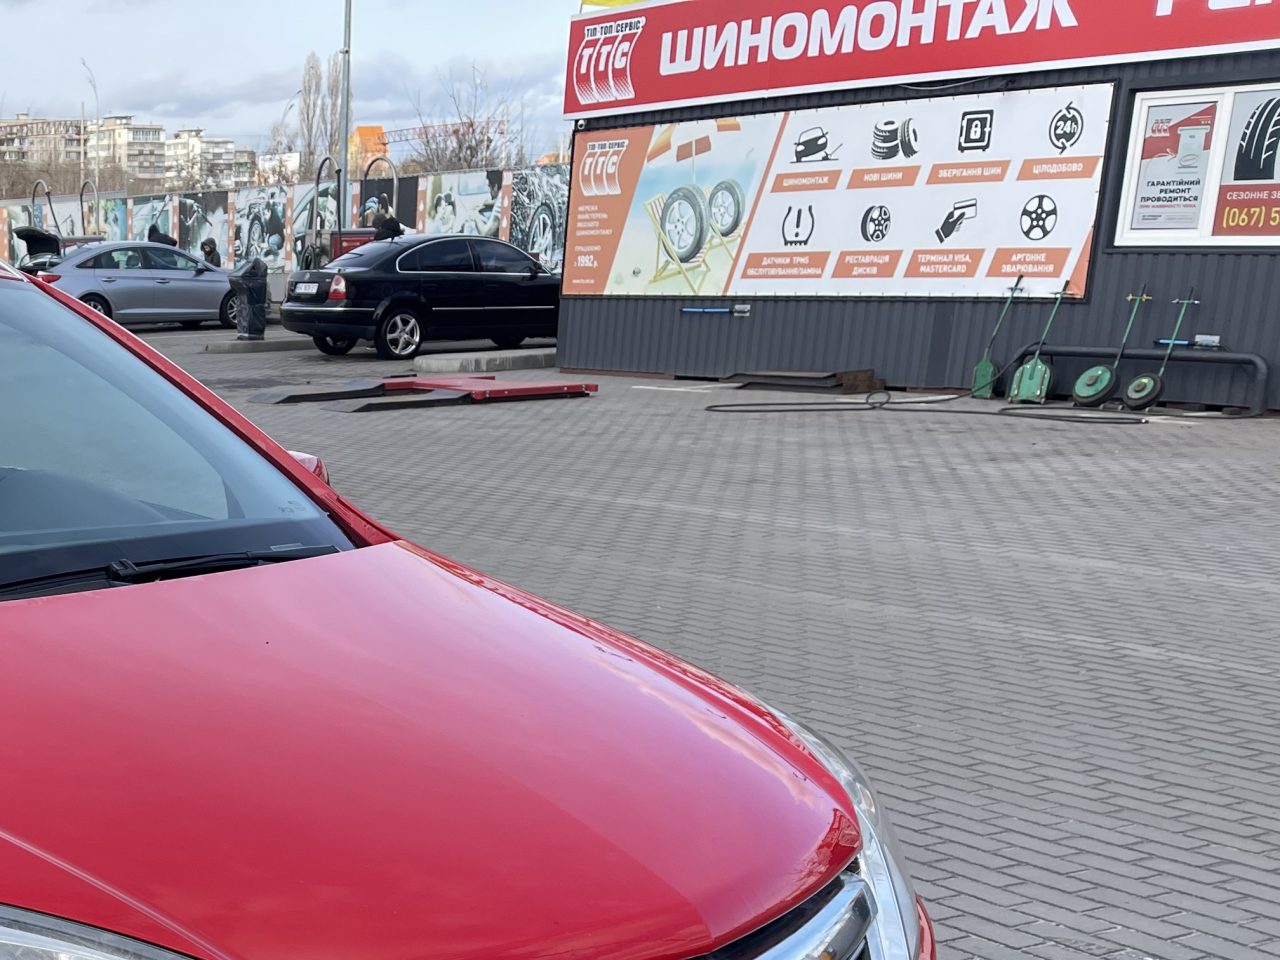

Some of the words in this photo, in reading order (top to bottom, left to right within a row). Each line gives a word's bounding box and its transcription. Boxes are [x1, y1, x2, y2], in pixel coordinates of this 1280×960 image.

[615, 20, 641, 34] СЕРВІС
[659, 0, 1079, 76] ШИНОМОНТАЖ
[1055, 120, 1078, 135] 24h
[938, 167, 982, 178] ЗБЕРІГАННЯ
[982, 166, 1002, 176] ШИН
[1032, 162, 1084, 174] ЦІЛОДОБОВО
[782, 175, 829, 187] ШИНОМОНТАЖ
[863, 173, 880, 182] НОВІ
[880, 171, 903, 181] ШИНИ
[1146, 178, 1201, 187] ГАРАНТІЙНИЙ
[1159, 187, 1192, 195] РЕМОНТ
[1226, 191, 1270, 200] СЕЗОННЕ
[1140, 195, 1198, 203] ПРОВОДИТЬСЯ
[1222, 205, 1266, 228] (067)
[1269, 207, 1280, 226] 5
[577, 255, 594, 268] 1992
[761, 256, 790, 266] ДАТЧИКИ
[845, 254, 890, 264] РЕСТАВРАЦІЯ
[918, 253, 954, 263] ТЕРМІНАЛ
[954, 253, 972, 263] VISA,
[1010, 252, 1047, 262] АРГОННЕ
[851, 266, 878, 276] ДИСКІВ
[919, 264, 967, 273] MASTERCARD
[1001, 263, 1054, 273] ЗВАРЮВАННЯ
